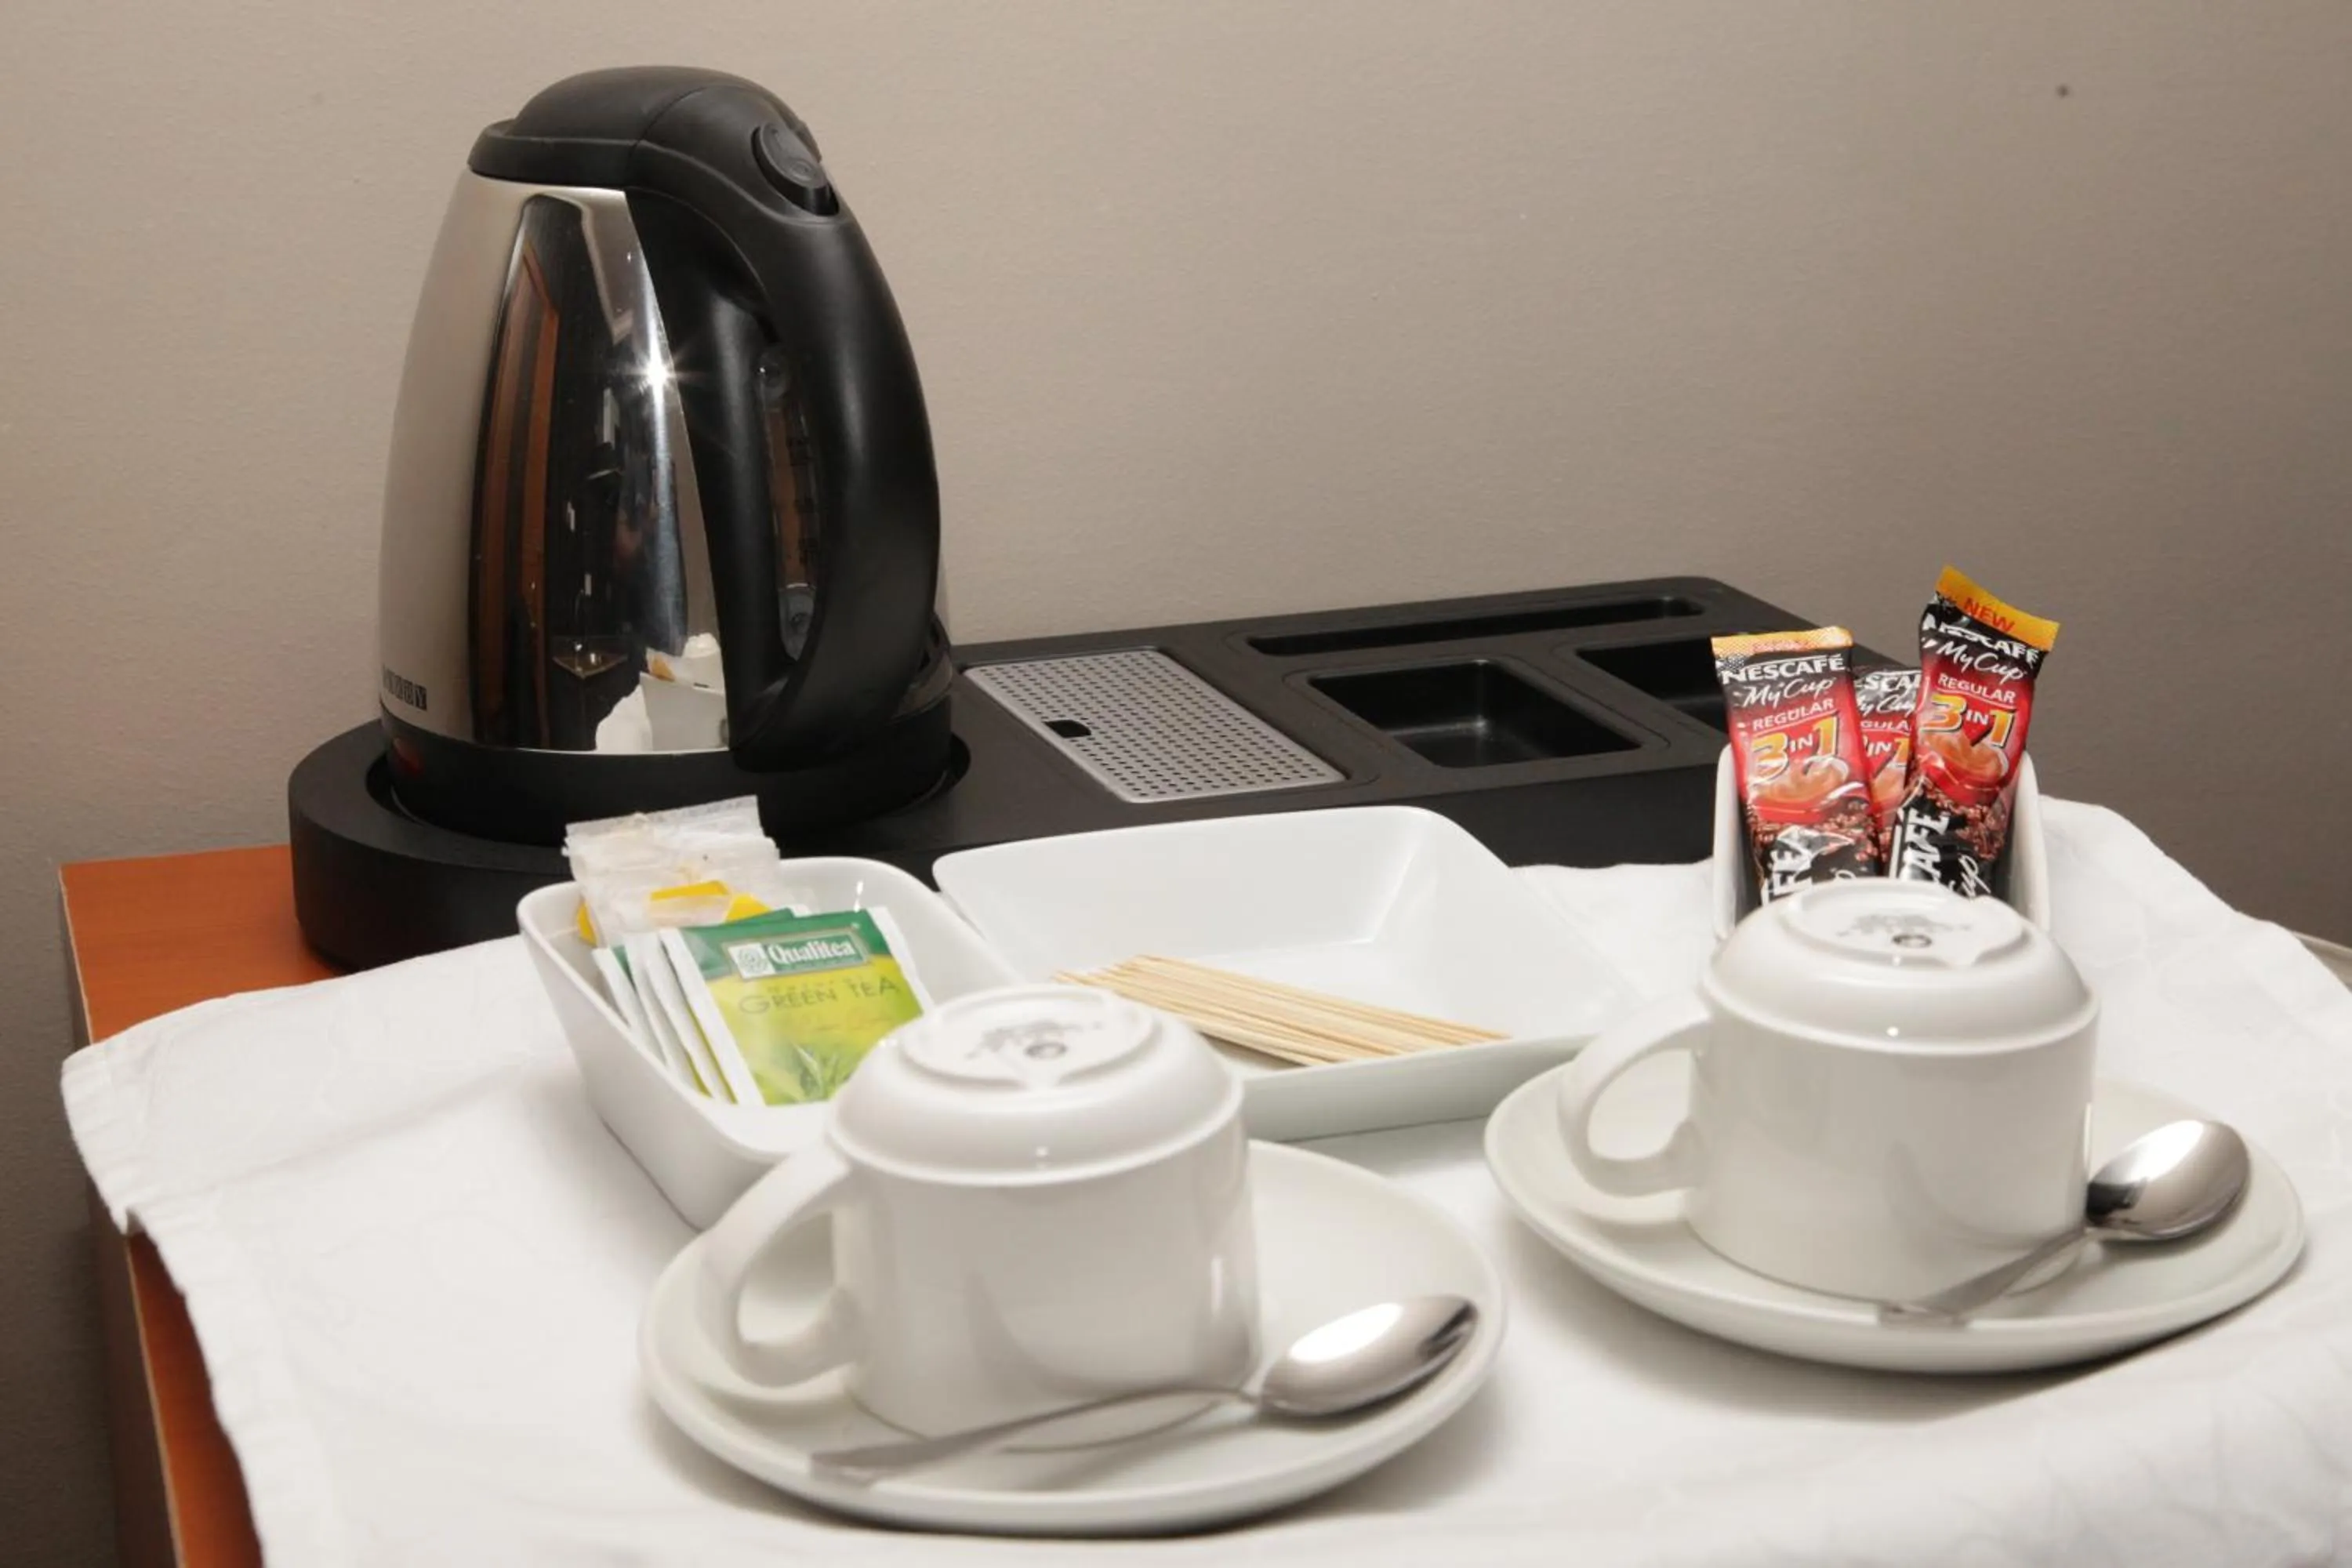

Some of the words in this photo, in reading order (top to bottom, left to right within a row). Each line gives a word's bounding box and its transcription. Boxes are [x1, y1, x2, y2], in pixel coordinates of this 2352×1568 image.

[1964, 597, 2015, 633] NEW
[1936, 641, 1973, 673] My
[1973, 652, 2025, 685] Cup
[1742, 684, 1784, 709] My
[1783, 677, 1836, 700] Cup
[1937, 673, 2016, 704] REGULAR
[1752, 698, 1835, 731] REGULAR
[1919, 694, 1968, 734] 3
[1965, 710, 1988, 725] IN
[1987, 709, 2015, 749] 1
[1751, 731, 1789, 782] 3
[1790, 734, 1813, 753] IN
[1813, 715, 1838, 756] 1
[767, 940, 856, 965] Qualitea
[739, 988, 839, 1014] GREEN
[844, 976, 899, 998] TEA
